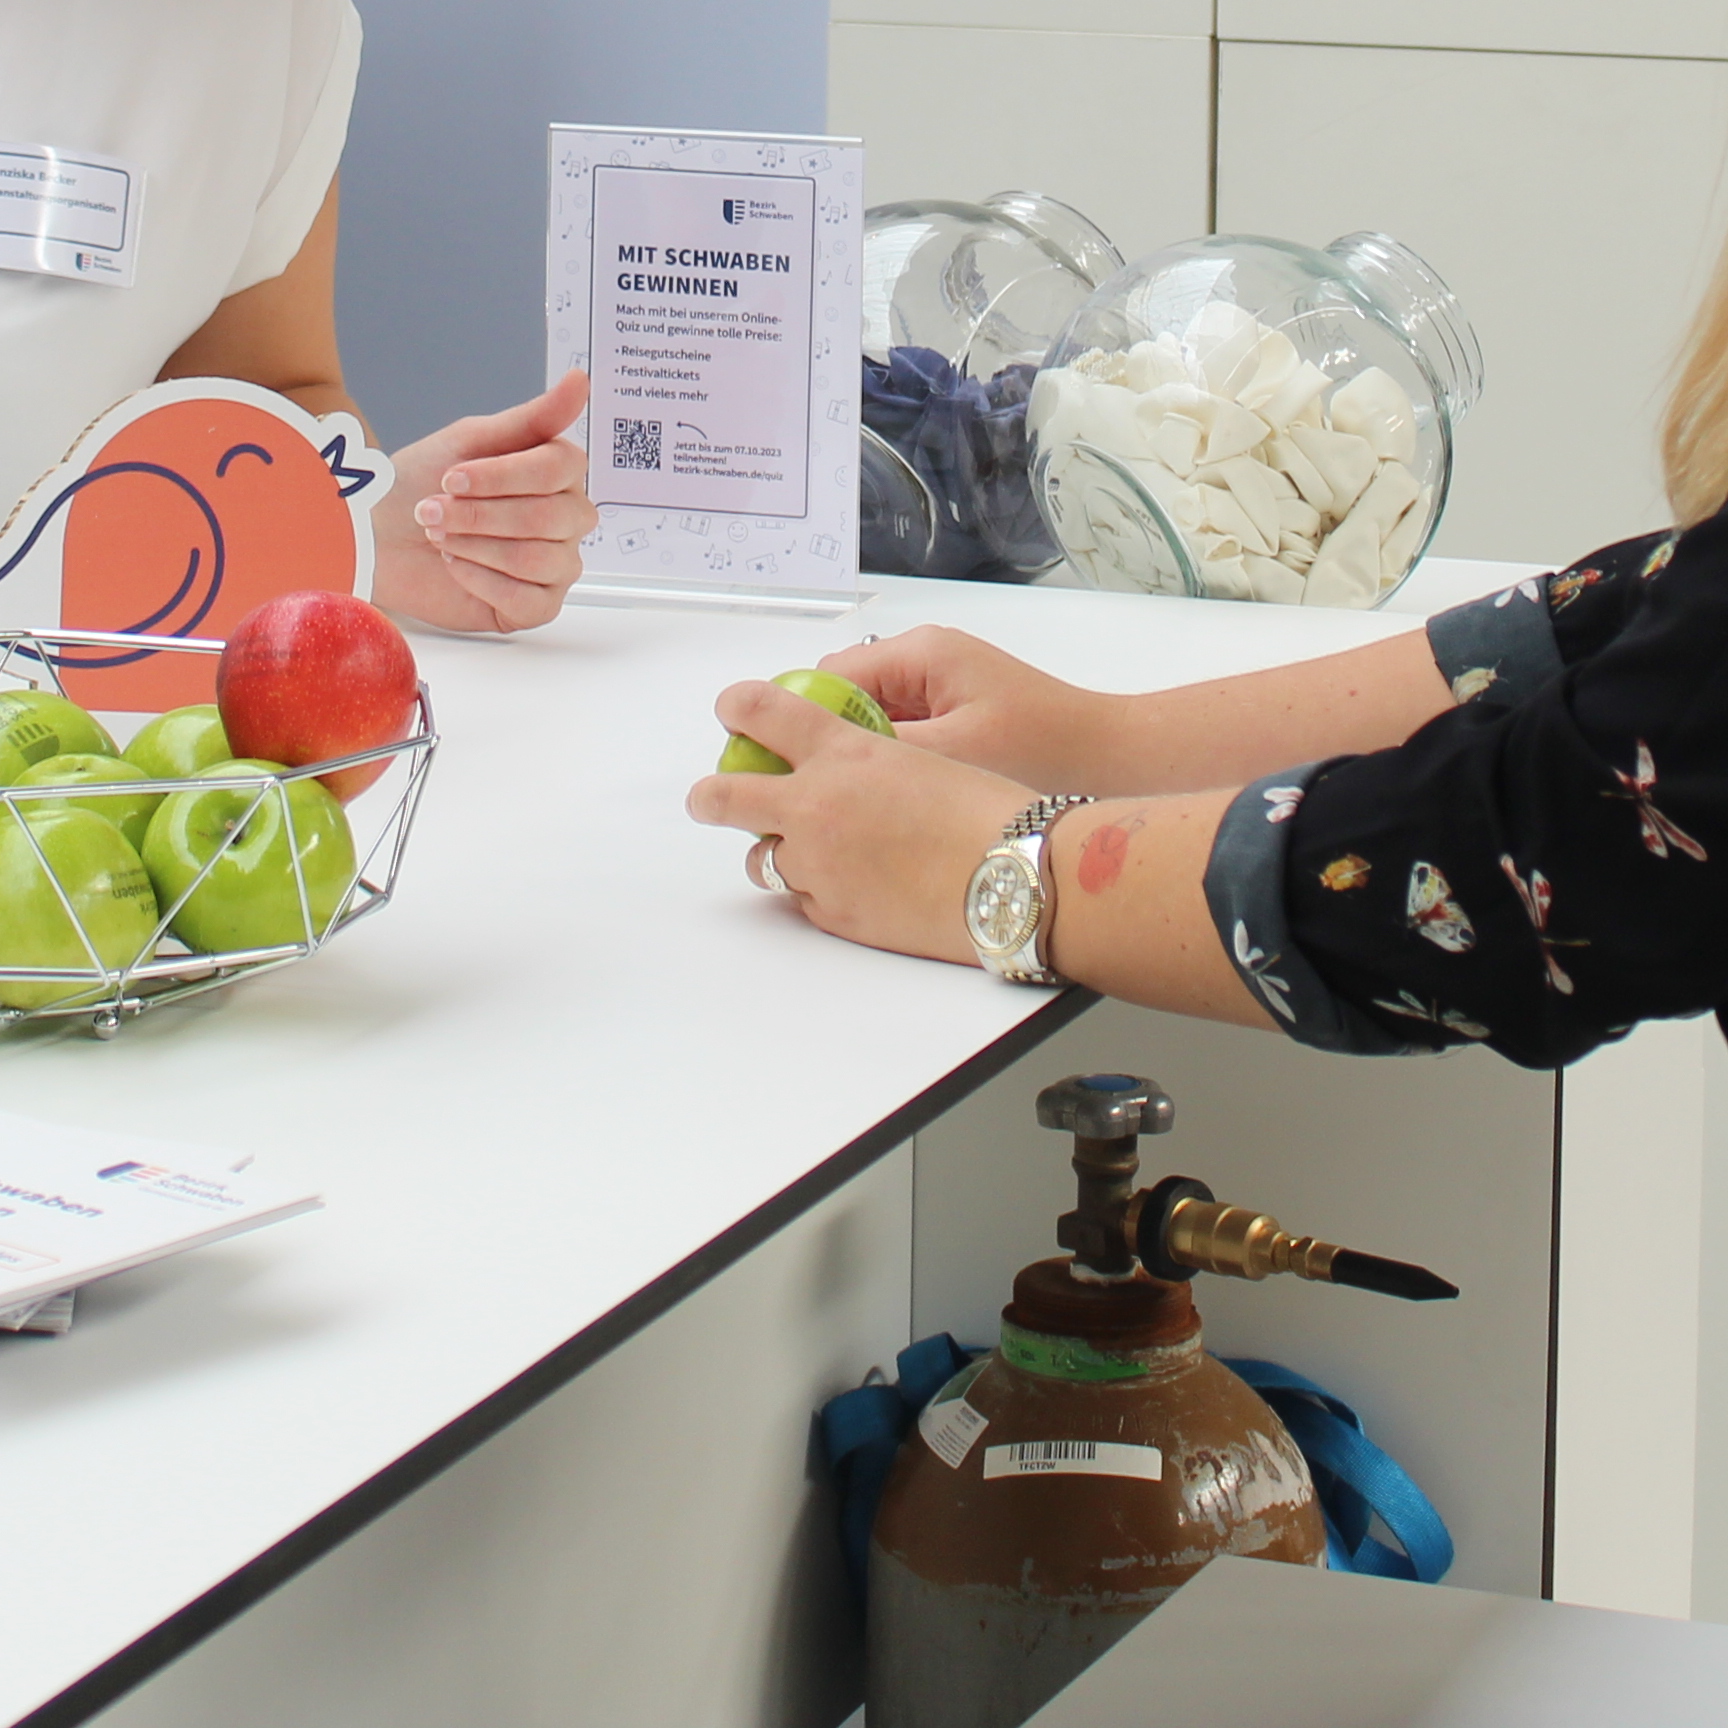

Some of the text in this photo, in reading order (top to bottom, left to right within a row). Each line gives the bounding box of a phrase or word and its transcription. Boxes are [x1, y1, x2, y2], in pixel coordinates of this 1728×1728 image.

[38, 170, 77, 187] Bcker
[749, 200, 777, 210] Bezirk
[749, 210, 794, 221] Schwaben
[617, 244, 790, 273] MIT SCHWABEN
[616, 272, 739, 298] GEWINNEN
[616, 304, 782, 325] Mach mit bei unserem Online-
[615, 320, 783, 342] Quiz und gewinne tolle Preise:
[621, 345, 712, 362] Reisegutscheine
[621, 365, 701, 381] Festivaltickets
[620, 386, 709, 402] und vieles mehr
[674, 441, 696, 452] Jetzt
[698, 442, 712, 452] bis
[713, 445, 733, 454] zum
[673, 453, 727, 465] teilnehmen!
[673, 464, 784, 483] bezirk-schwaben.de/quiz
